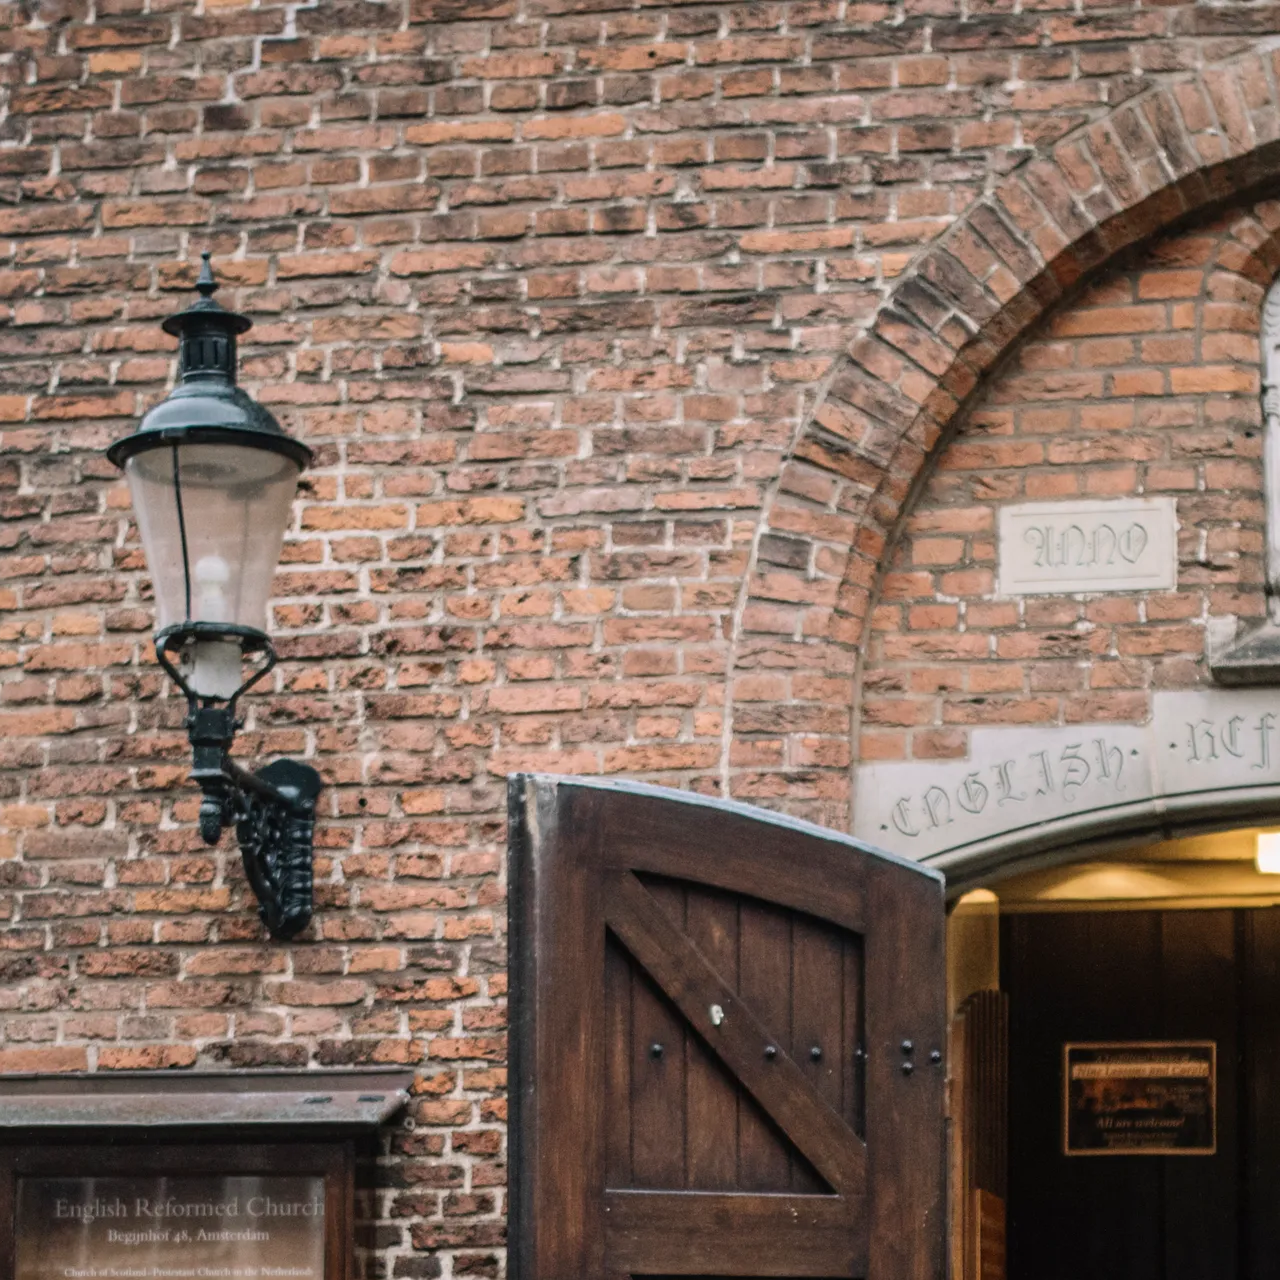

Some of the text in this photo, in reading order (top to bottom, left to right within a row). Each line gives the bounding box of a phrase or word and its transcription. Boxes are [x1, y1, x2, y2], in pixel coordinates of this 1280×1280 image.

[1022, 521, 1149, 568] ANNO
[54, 1196, 325, 1224] English Reformed Church
[108, 1229, 270, 1245] Begijnhof 48, Amsterdam
[64, 1267, 97, 1277] Church
[197, 1267, 231, 1277] Church
